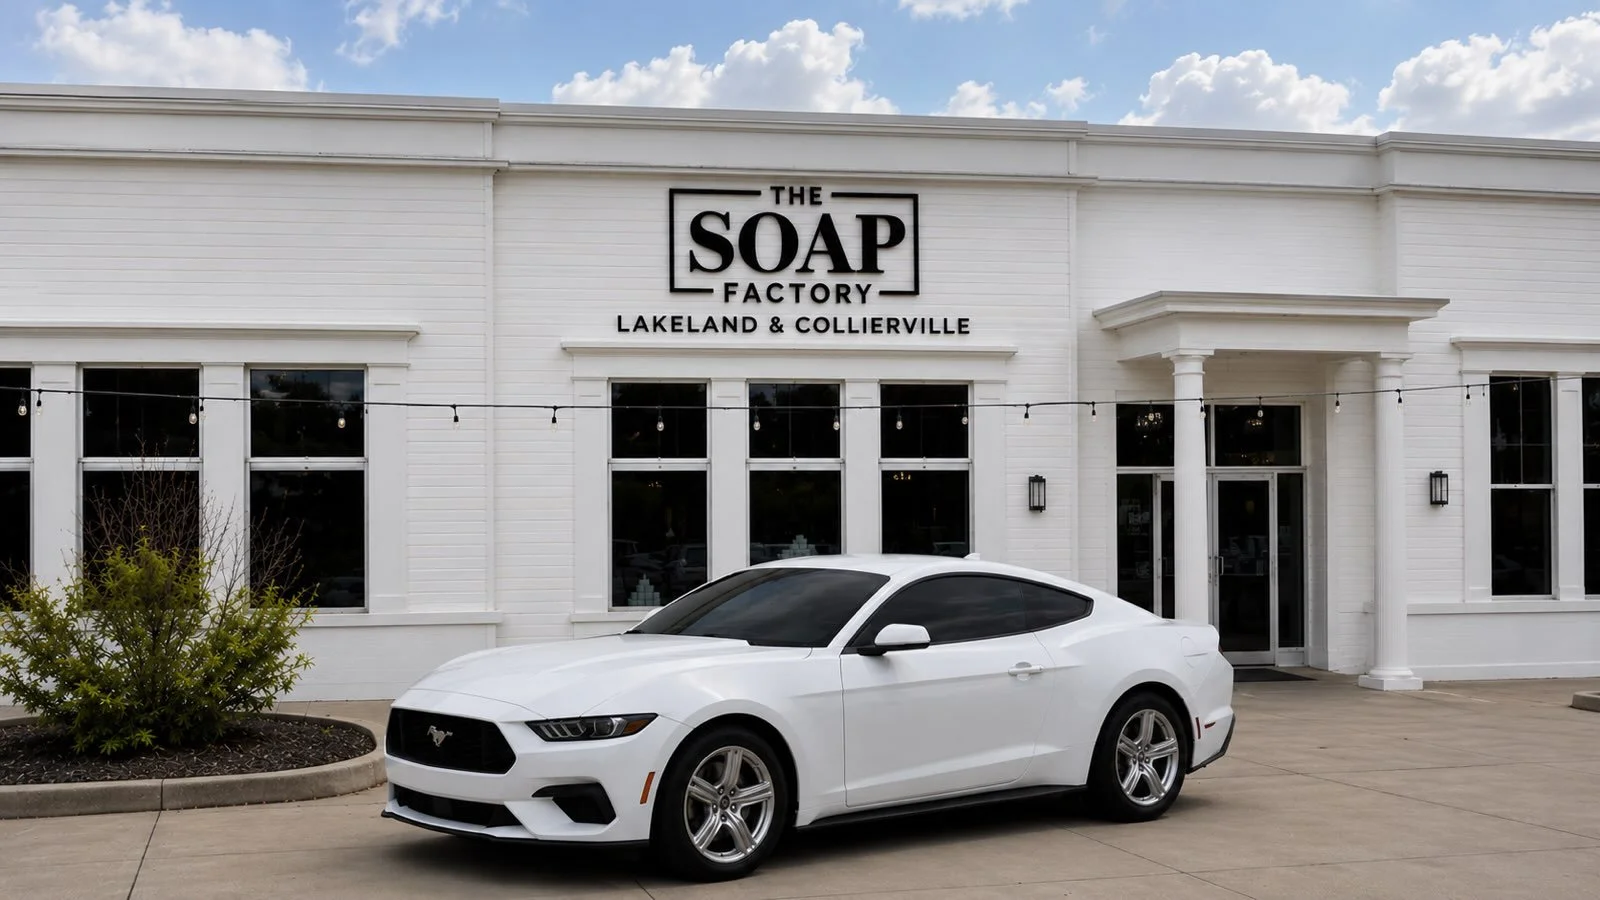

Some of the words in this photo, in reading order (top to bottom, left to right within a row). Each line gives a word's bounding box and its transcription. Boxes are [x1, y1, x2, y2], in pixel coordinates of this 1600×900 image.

[769, 185, 823, 206] THE
[689, 210, 906, 275] SOAP
[723, 282, 872, 305] FACTORY
[617, 314, 758, 334] LAKELAND
[769, 316, 785, 334] &
[795, 316, 970, 335] COLLIERVILLE
